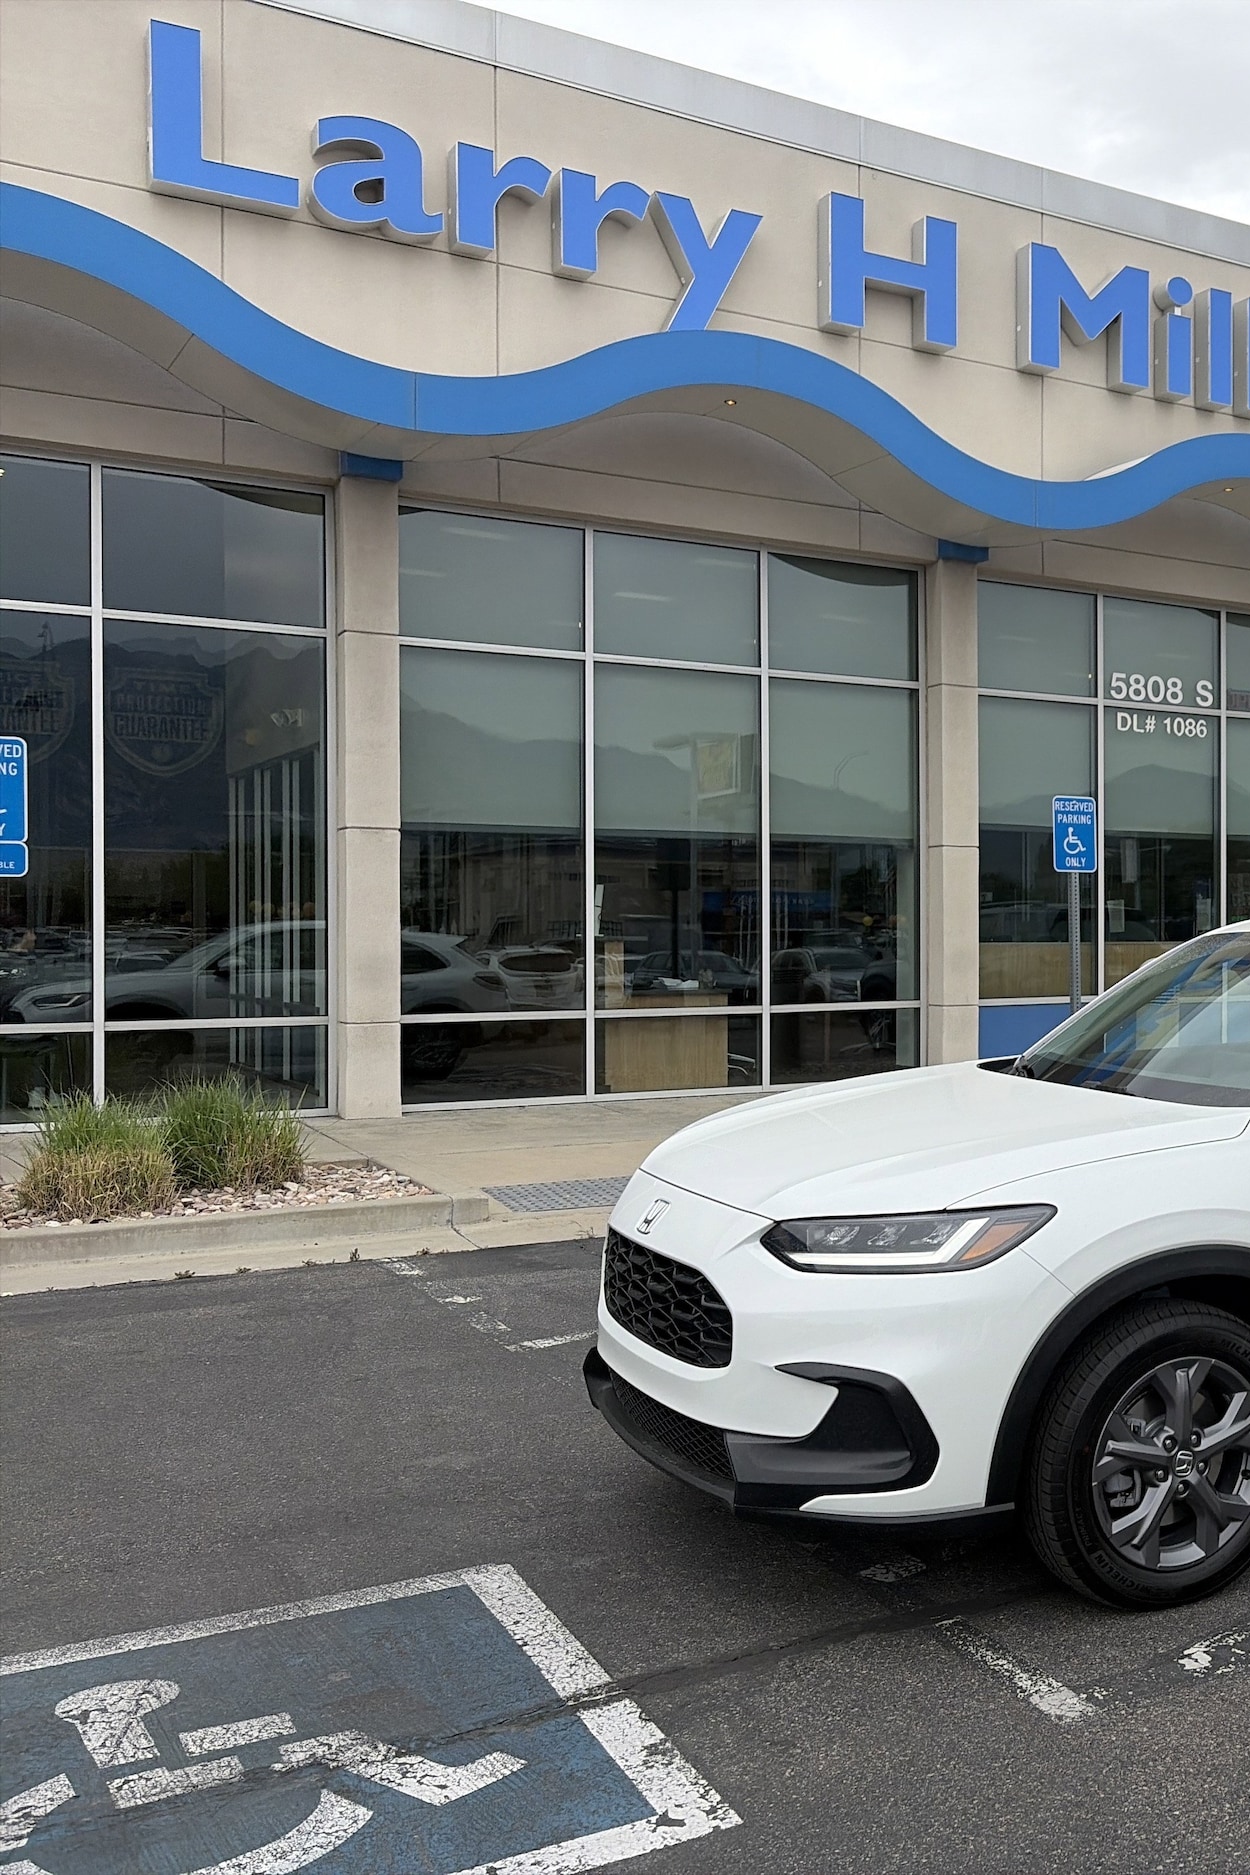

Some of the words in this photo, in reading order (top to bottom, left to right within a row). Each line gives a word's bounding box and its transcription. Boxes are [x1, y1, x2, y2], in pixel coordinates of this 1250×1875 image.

[146, 18, 763, 331] Larry
[818, 191, 957, 353] H
[1110, 672, 1183, 704] 5808
[1196, 680, 1213, 707] S
[113, 714, 209, 740] GUARANTEE
[1117, 712, 1156, 733] DL#
[1163, 717, 1207, 738] 1086
[1054, 800, 1094, 812] RESERVED
[1057, 813, 1092, 825] PARKING
[1065, 856, 1086, 867] ONLY
